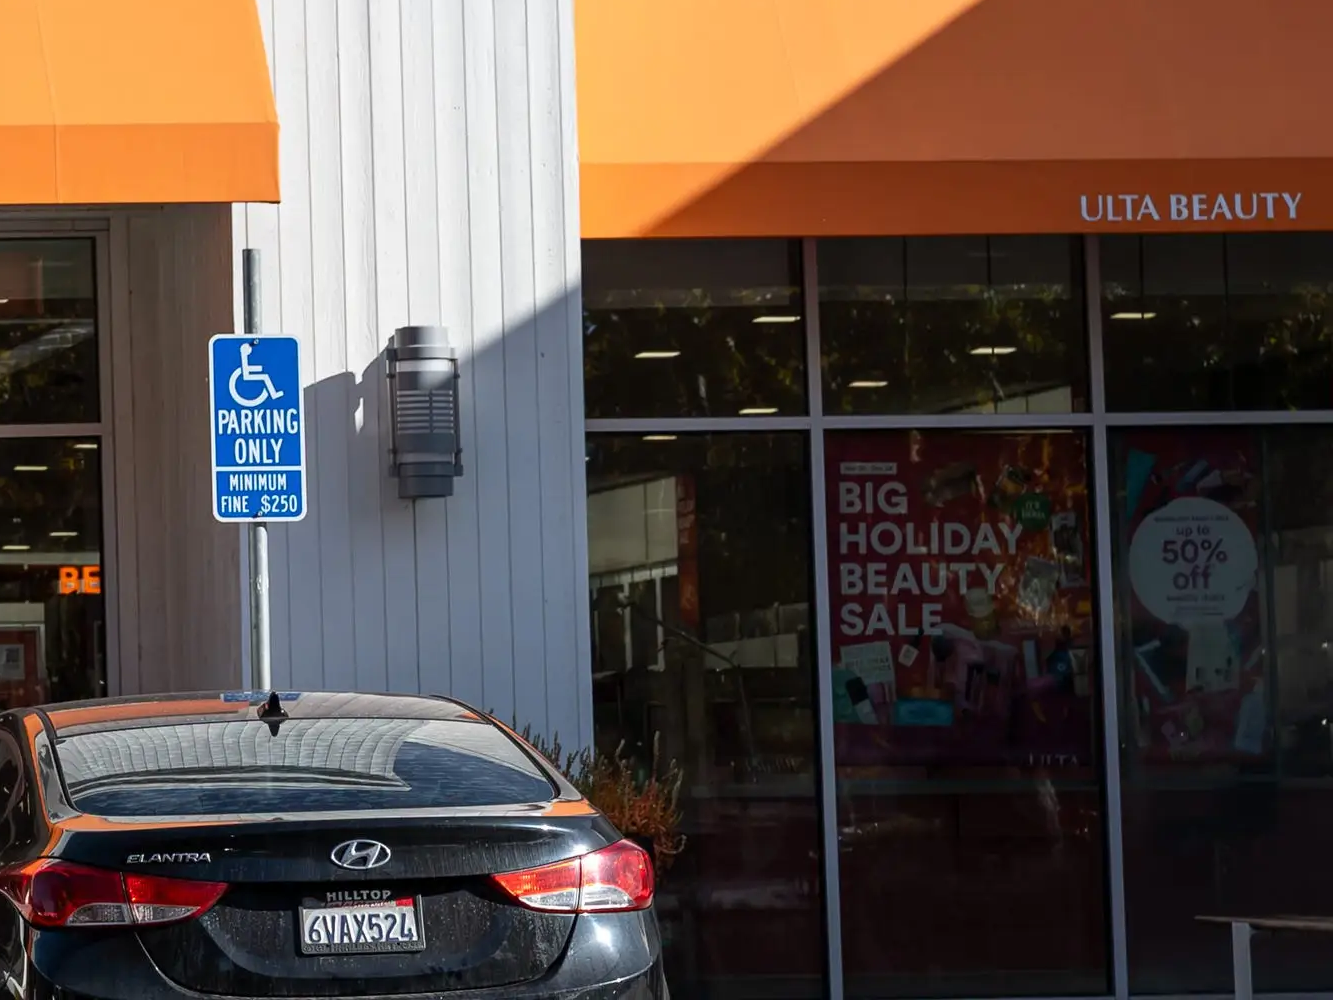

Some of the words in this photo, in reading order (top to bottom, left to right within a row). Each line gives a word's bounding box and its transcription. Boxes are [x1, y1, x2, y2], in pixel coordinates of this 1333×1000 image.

[1079, 194, 1161, 222] ULTA
[1169, 192, 1302, 221] BEAUTY
[217, 408, 298, 435] PARKING
[234, 437, 283, 464] ONLY
[229, 473, 287, 492] MINIMUM
[220, 495, 250, 513] FINE
[260, 494, 298, 514] $250
[838, 481, 909, 515] BIG
[839, 521, 1023, 555] HOLIDAY
[1176, 525, 1193, 538] up
[1197, 524, 1210, 536] to
[1161, 538, 1228, 565] 50%
[839, 562, 1006, 596] BEAUTY
[1172, 564, 1212, 591] off
[839, 602, 944, 637] SALE
[126, 852, 212, 864] ELANTRA
[325, 889, 392, 902] HILLTOP
[308, 912, 415, 944] 6VAX524
